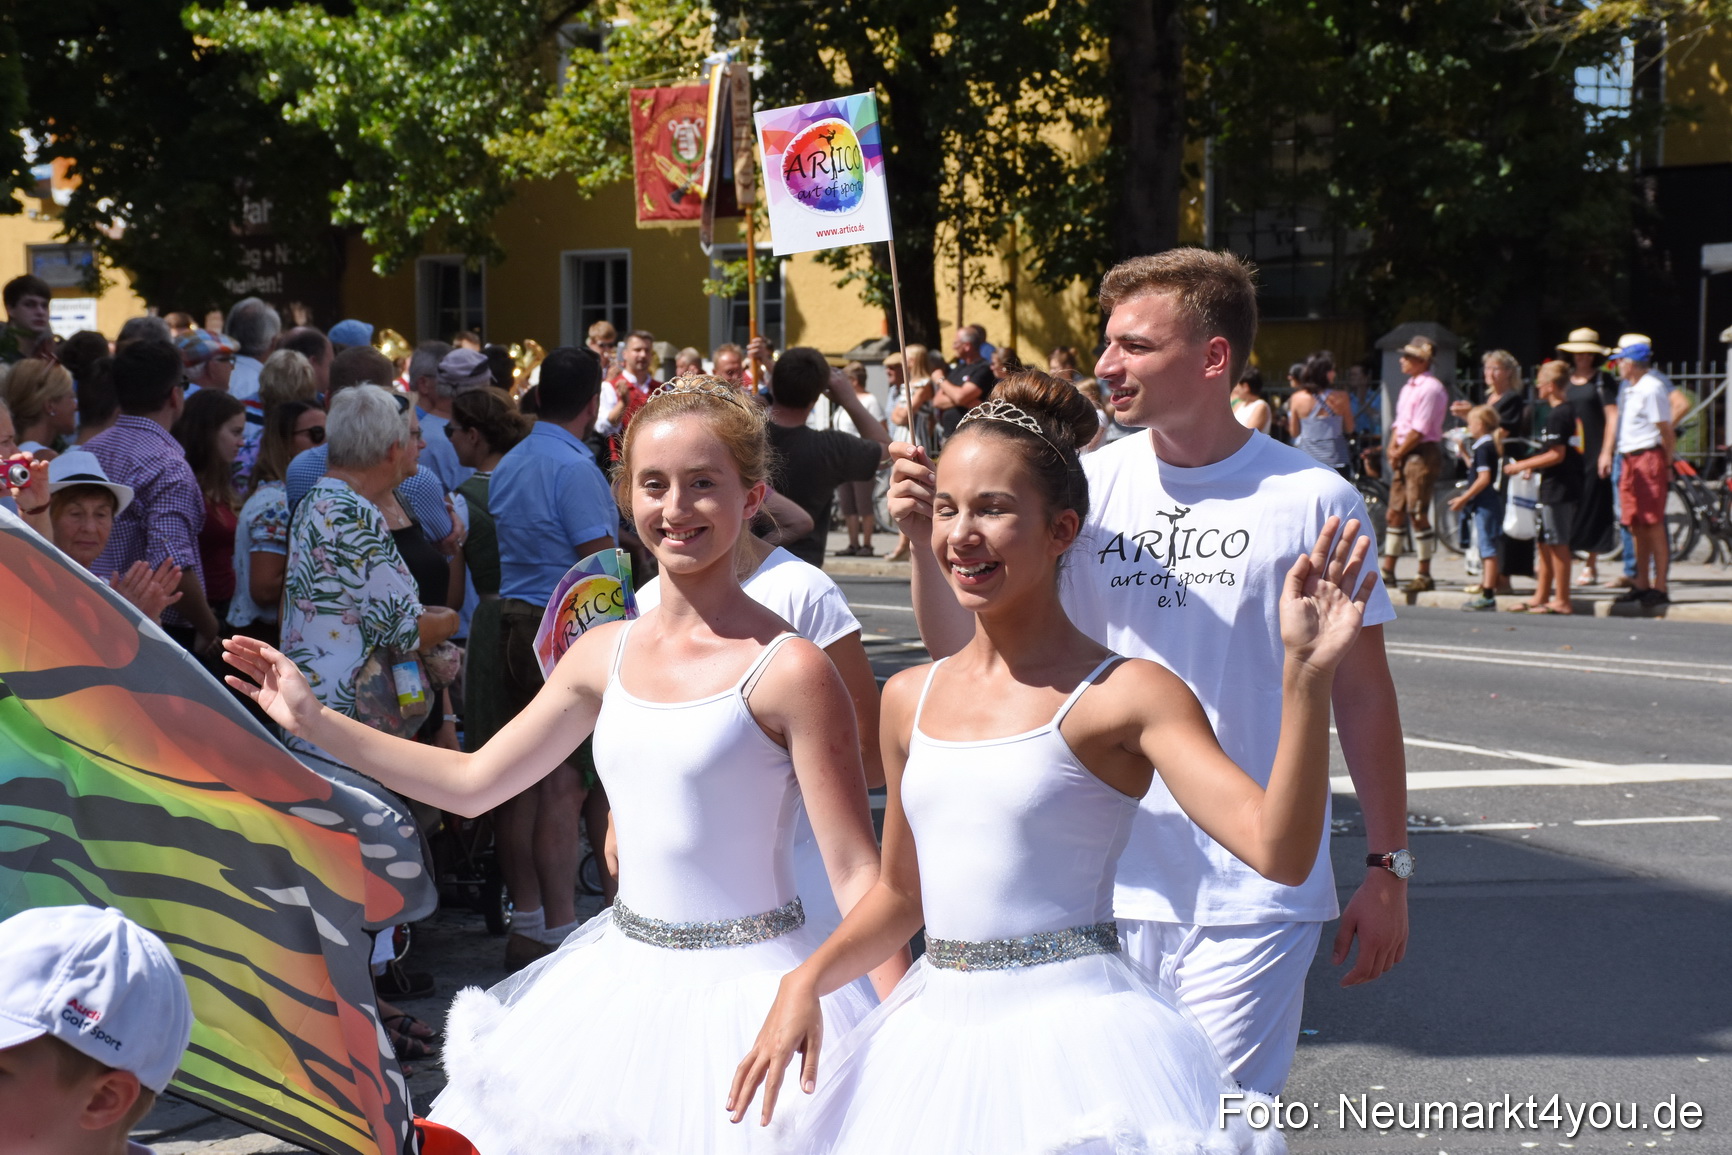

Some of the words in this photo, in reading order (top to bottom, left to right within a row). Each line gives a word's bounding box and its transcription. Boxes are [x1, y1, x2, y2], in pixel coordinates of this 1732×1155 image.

[784, 129, 861, 181] ARTICO
[797, 185, 822, 200] art
[825, 181, 839, 197] of
[815, 223, 865, 238] www.artico.de
[1098, 505, 1250, 568] ARTICO
[1111, 570, 1147, 588] art
[1150, 568, 1175, 589] of
[1177, 569, 1236, 592] sports
[61, 1009, 92, 1030] Golf
[66, 998, 101, 1021] Audi
